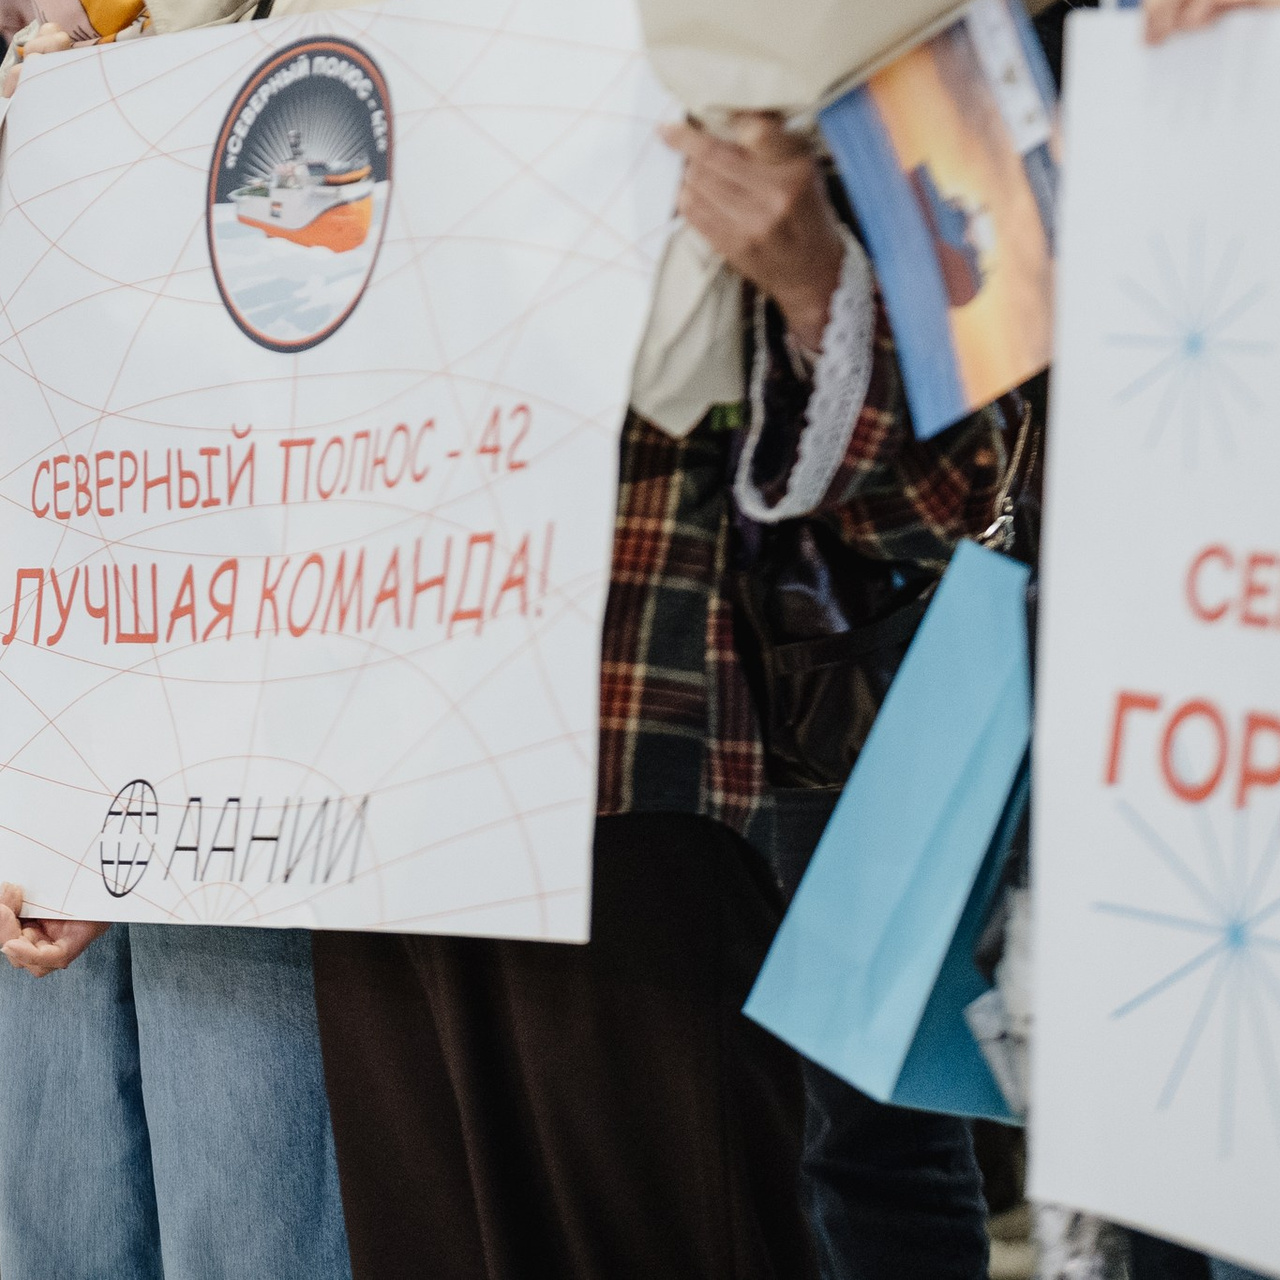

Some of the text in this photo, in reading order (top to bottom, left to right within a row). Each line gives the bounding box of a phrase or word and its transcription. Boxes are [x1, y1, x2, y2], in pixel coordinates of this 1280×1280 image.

[31, 422, 257, 520] СЕВЕРНЫЙ
[278, 417, 437, 505] ПОЛЮС
[473, 403, 533, 475] 42
[1, 520, 558, 647] ЛУЧШАЯ КОМАНДА!
[1181, 541, 1280, 632] СЕ
[164, 793, 372, 884] ААНИИ
